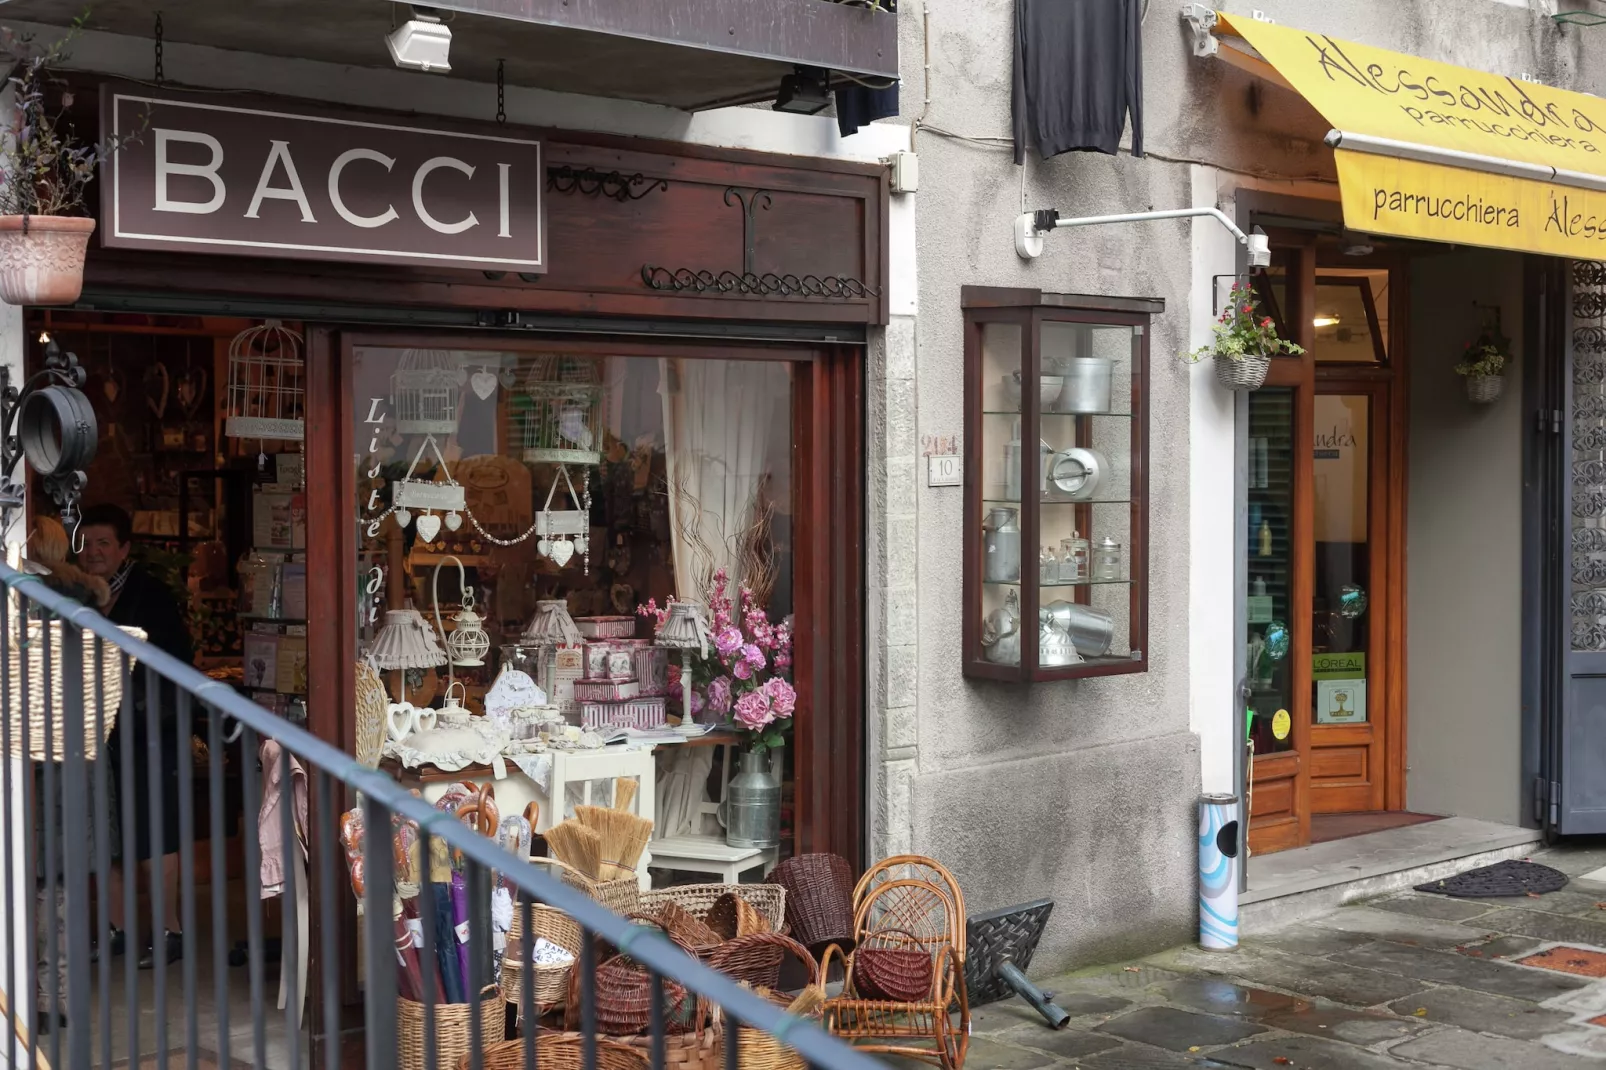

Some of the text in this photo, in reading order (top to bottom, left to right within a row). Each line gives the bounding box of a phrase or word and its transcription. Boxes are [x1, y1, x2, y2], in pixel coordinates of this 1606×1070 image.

[1306, 34, 1606, 134] Alessandra
[1400, 104, 1601, 154] parrucchiera
[152, 128, 512, 238] BACCI
[1373, 187, 1520, 228] parrucchiera
[939, 459, 953, 476] 10
